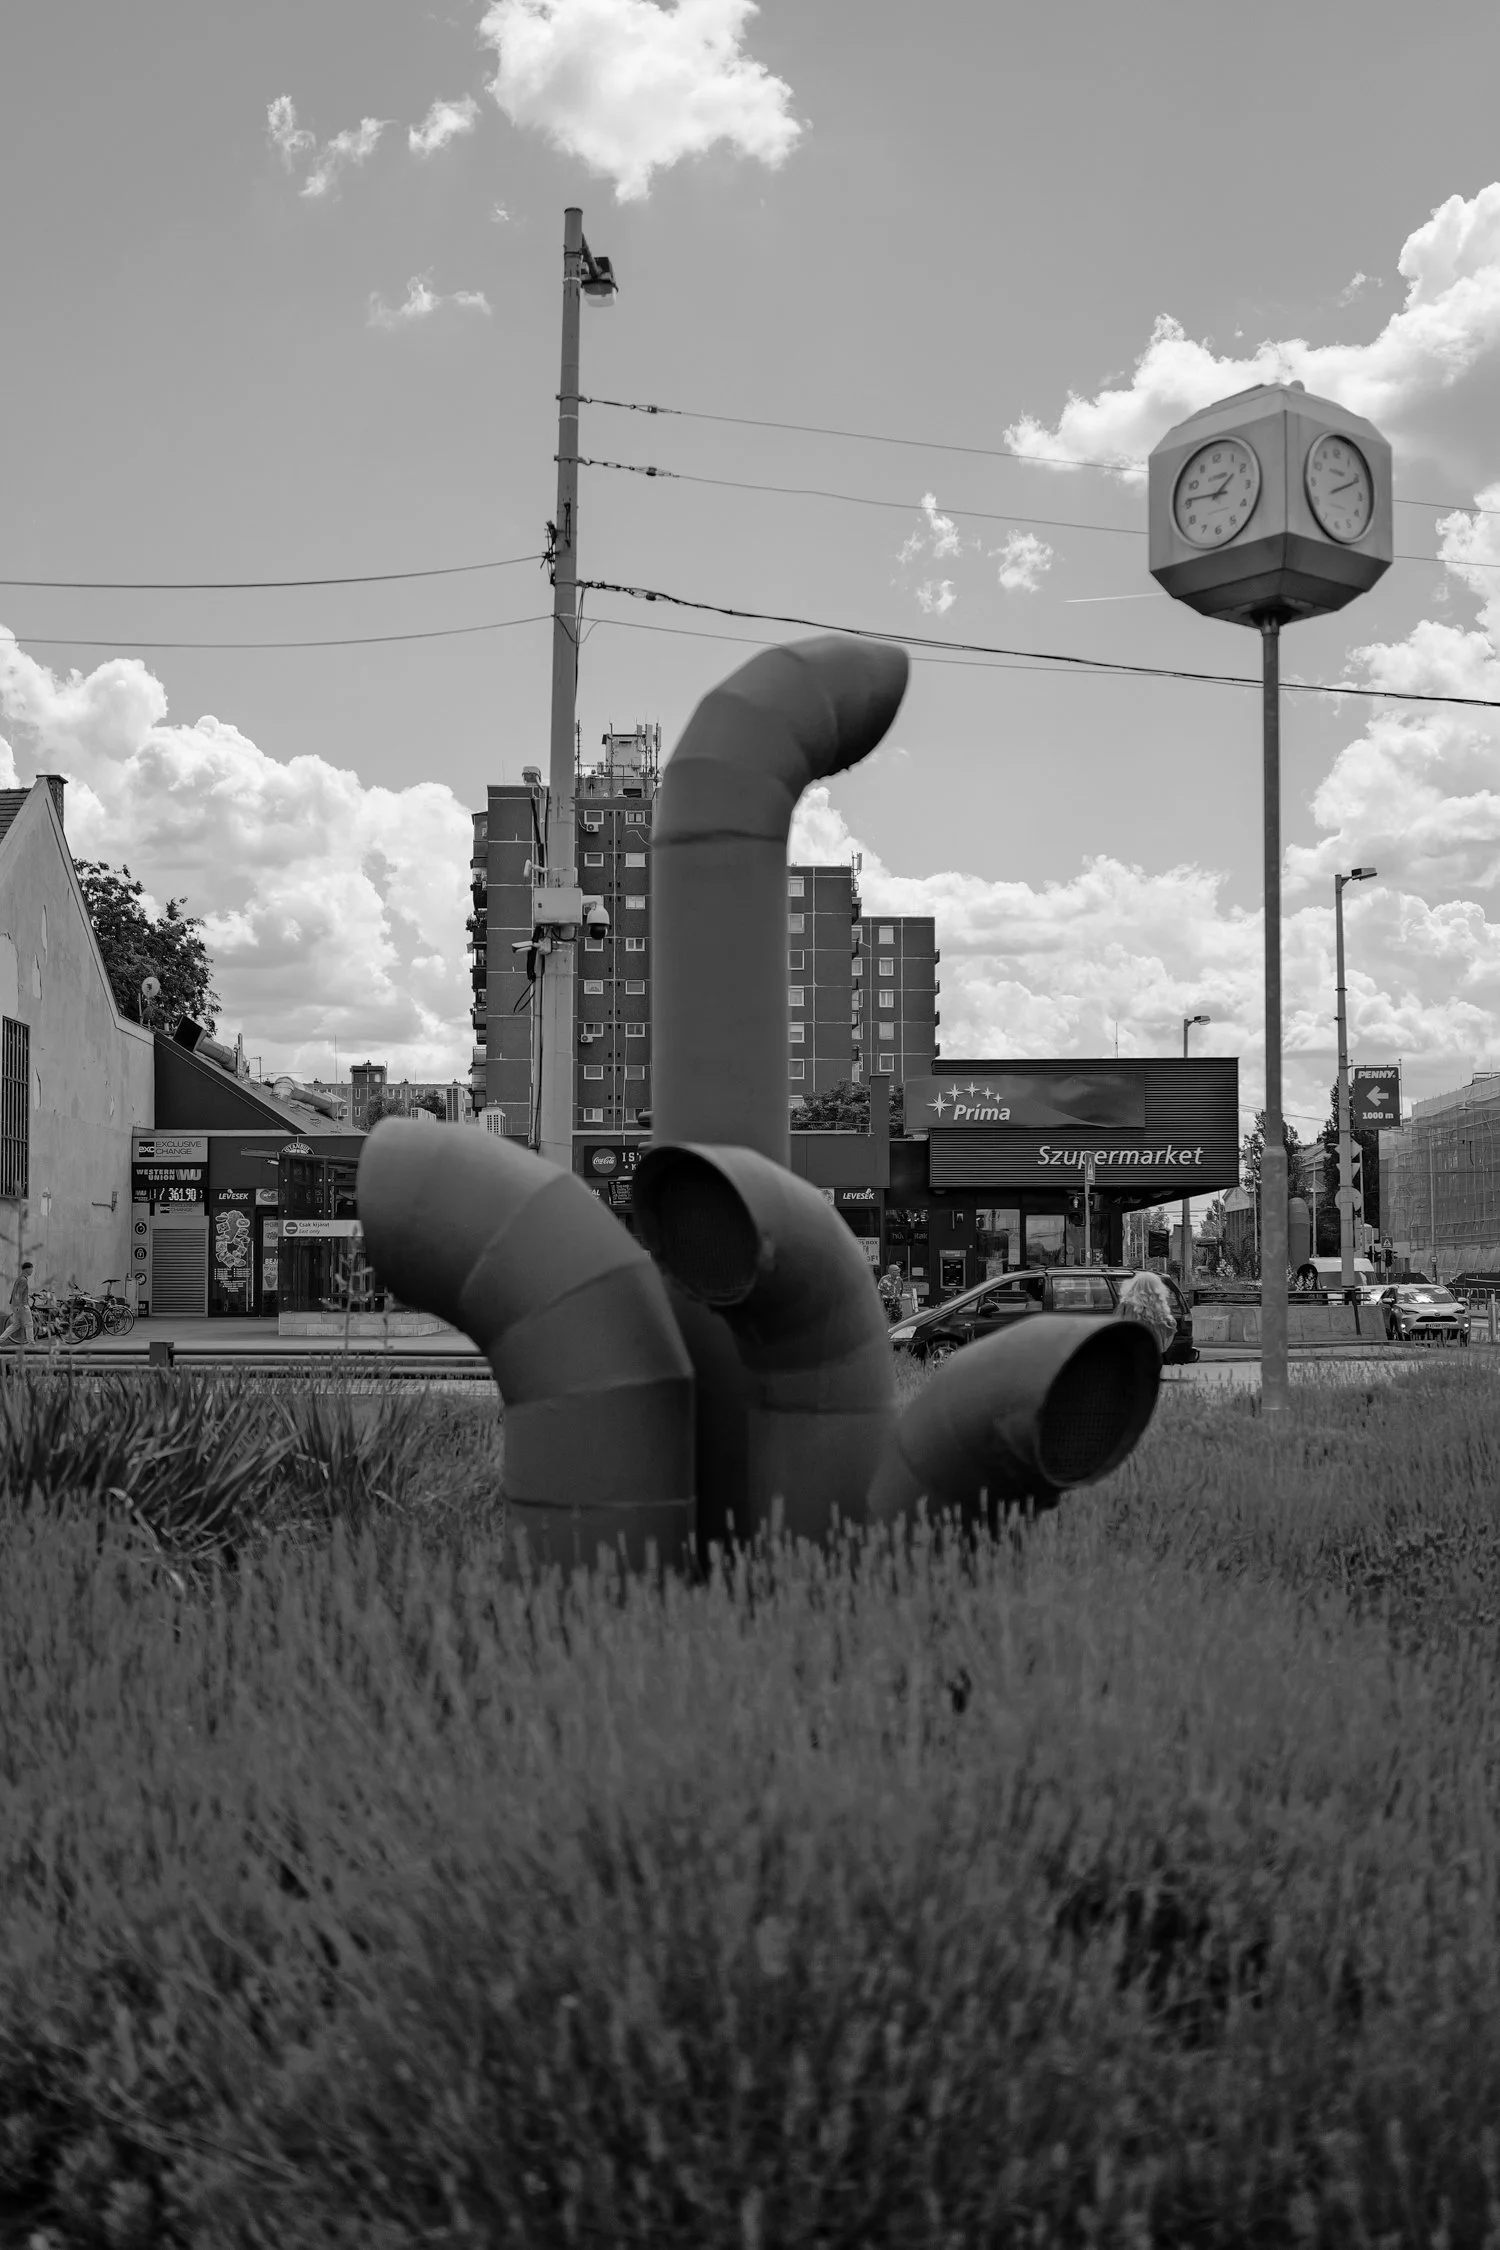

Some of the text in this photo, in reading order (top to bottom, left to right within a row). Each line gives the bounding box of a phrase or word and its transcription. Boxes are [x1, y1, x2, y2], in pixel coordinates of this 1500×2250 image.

[1212, 453, 1222, 464] 12
[1240, 463, 1247, 473] 2
[1189, 480, 1200, 490] 10
[1245, 479, 1251, 490] 3
[1185, 499, 1192, 510] 9
[1240, 498, 1247, 507] 4
[1188, 515, 1197, 525] 8
[1230, 515, 1237, 525] 5
[1201, 525, 1208, 534] 7
[1215, 525, 1222, 535] 6
[953, 1104, 1011, 1121] Príma
[1363, 1112, 1384, 1120] 1000
[843, 1192, 875, 1200] LEVESEK
